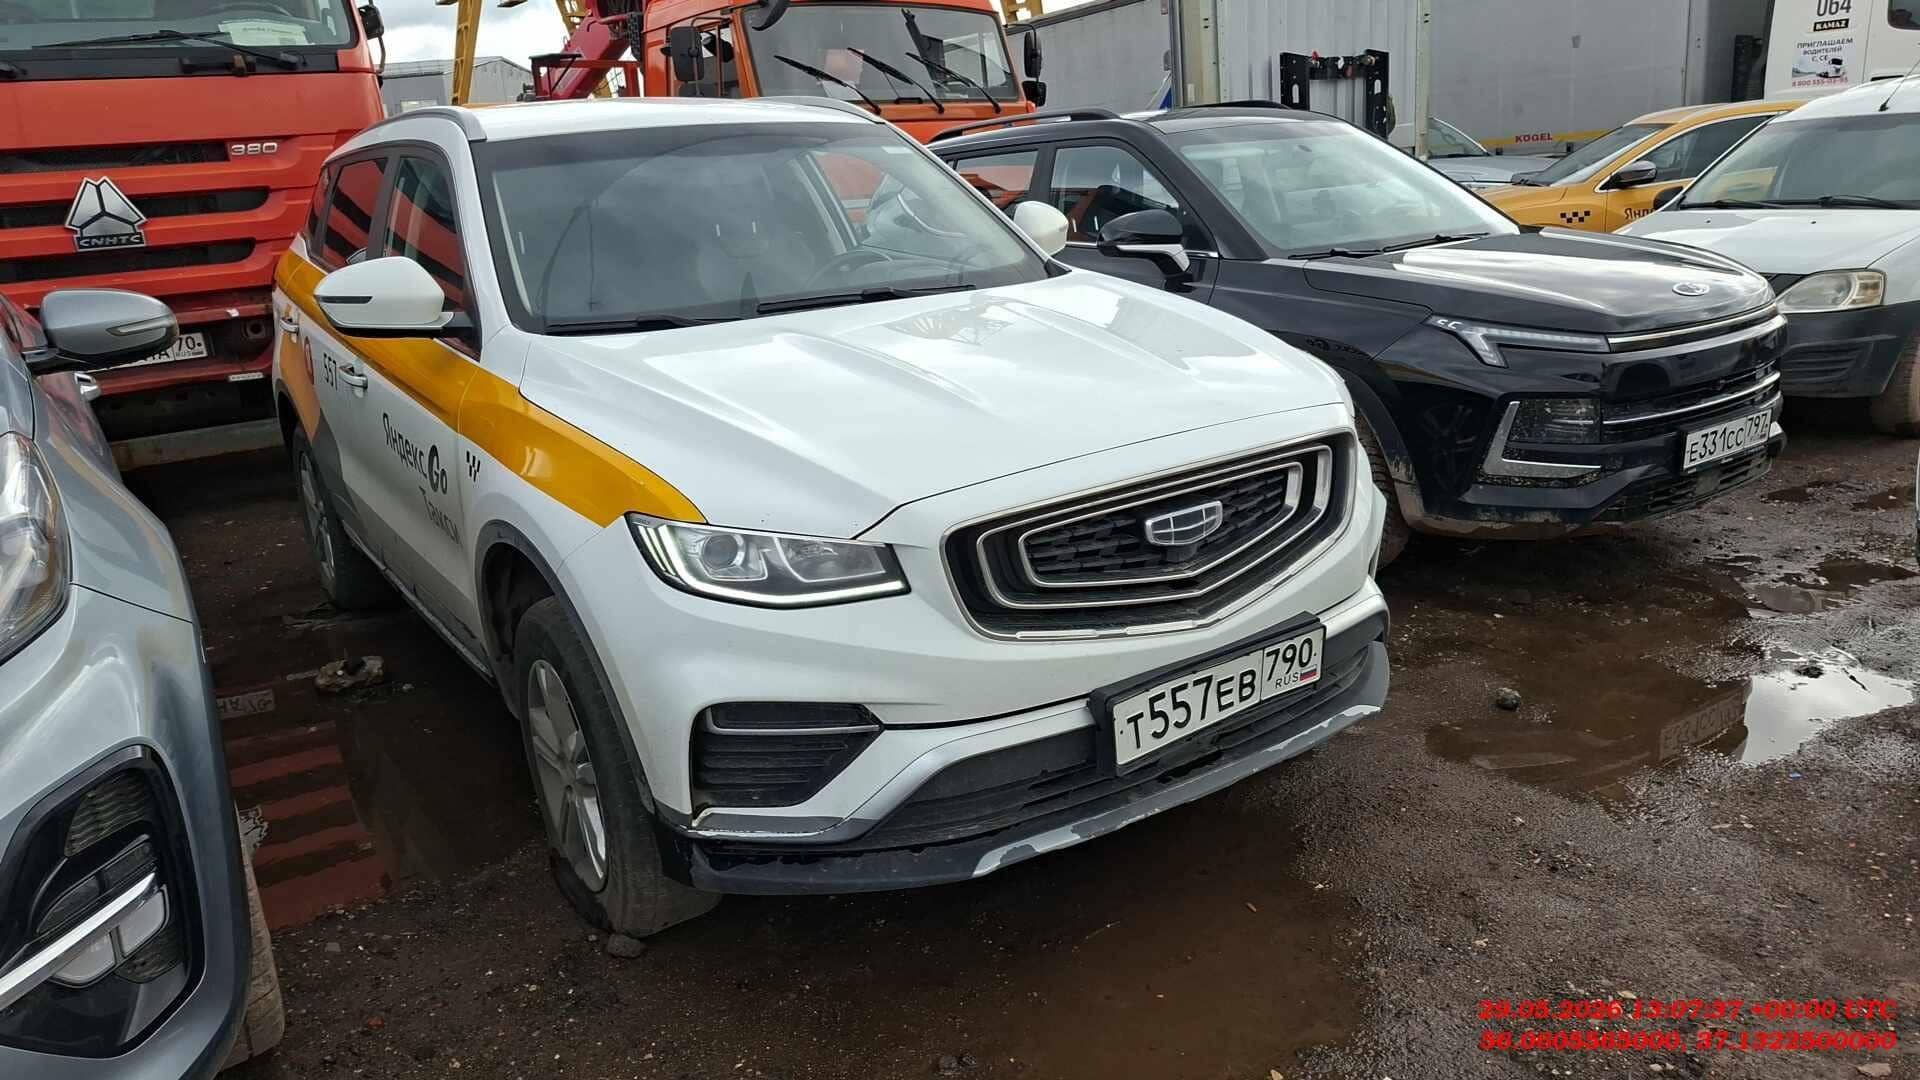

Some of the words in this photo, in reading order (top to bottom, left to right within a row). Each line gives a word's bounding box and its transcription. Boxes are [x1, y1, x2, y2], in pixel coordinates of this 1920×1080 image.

[1815, 20, 1847, 30] KAMAZ
[1797, 38, 1853, 49] ПРИГЛАШАЕМ
[1803, 46, 1842, 55] ВОДИТЕЛЕЙ
[231, 142, 278, 155] 380
[79, 234, 141, 247] CNHTC
[323, 352, 338, 391] 557
[1689, 427, 1744, 463] Е331СС
[1748, 413, 1768, 437] 797
[383, 413, 428, 480] Яндекс
[427, 445, 448, 495] Go
[418, 485, 460, 545] Такси
[1275, 671, 1299, 689] RUS
[1126, 669, 1257, 750] Т557ЕВ
[1265, 637, 1314, 682] 790
